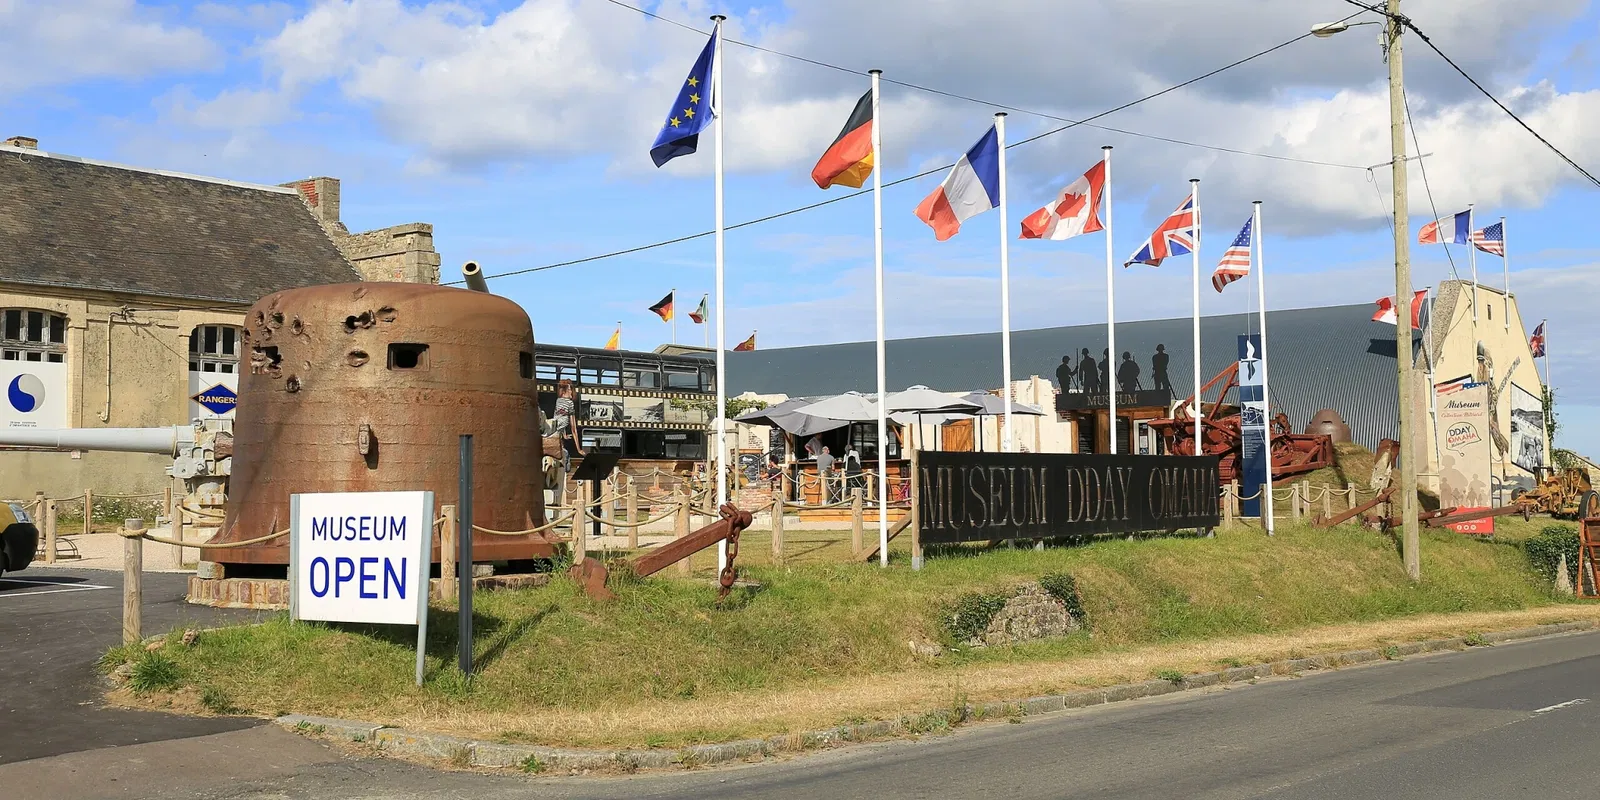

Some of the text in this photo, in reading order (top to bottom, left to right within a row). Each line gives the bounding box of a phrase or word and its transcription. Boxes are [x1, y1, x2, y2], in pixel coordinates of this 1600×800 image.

[1444, 400, 1480, 409] Museum
[1448, 433, 1477, 443] OMAHA
[1449, 426, 1471, 437] DDAY
[921, 464, 1219, 530] MUSEUM DDAY OMAHA
[311, 515, 406, 541] MUSEUM
[309, 556, 407, 600] OPEN
